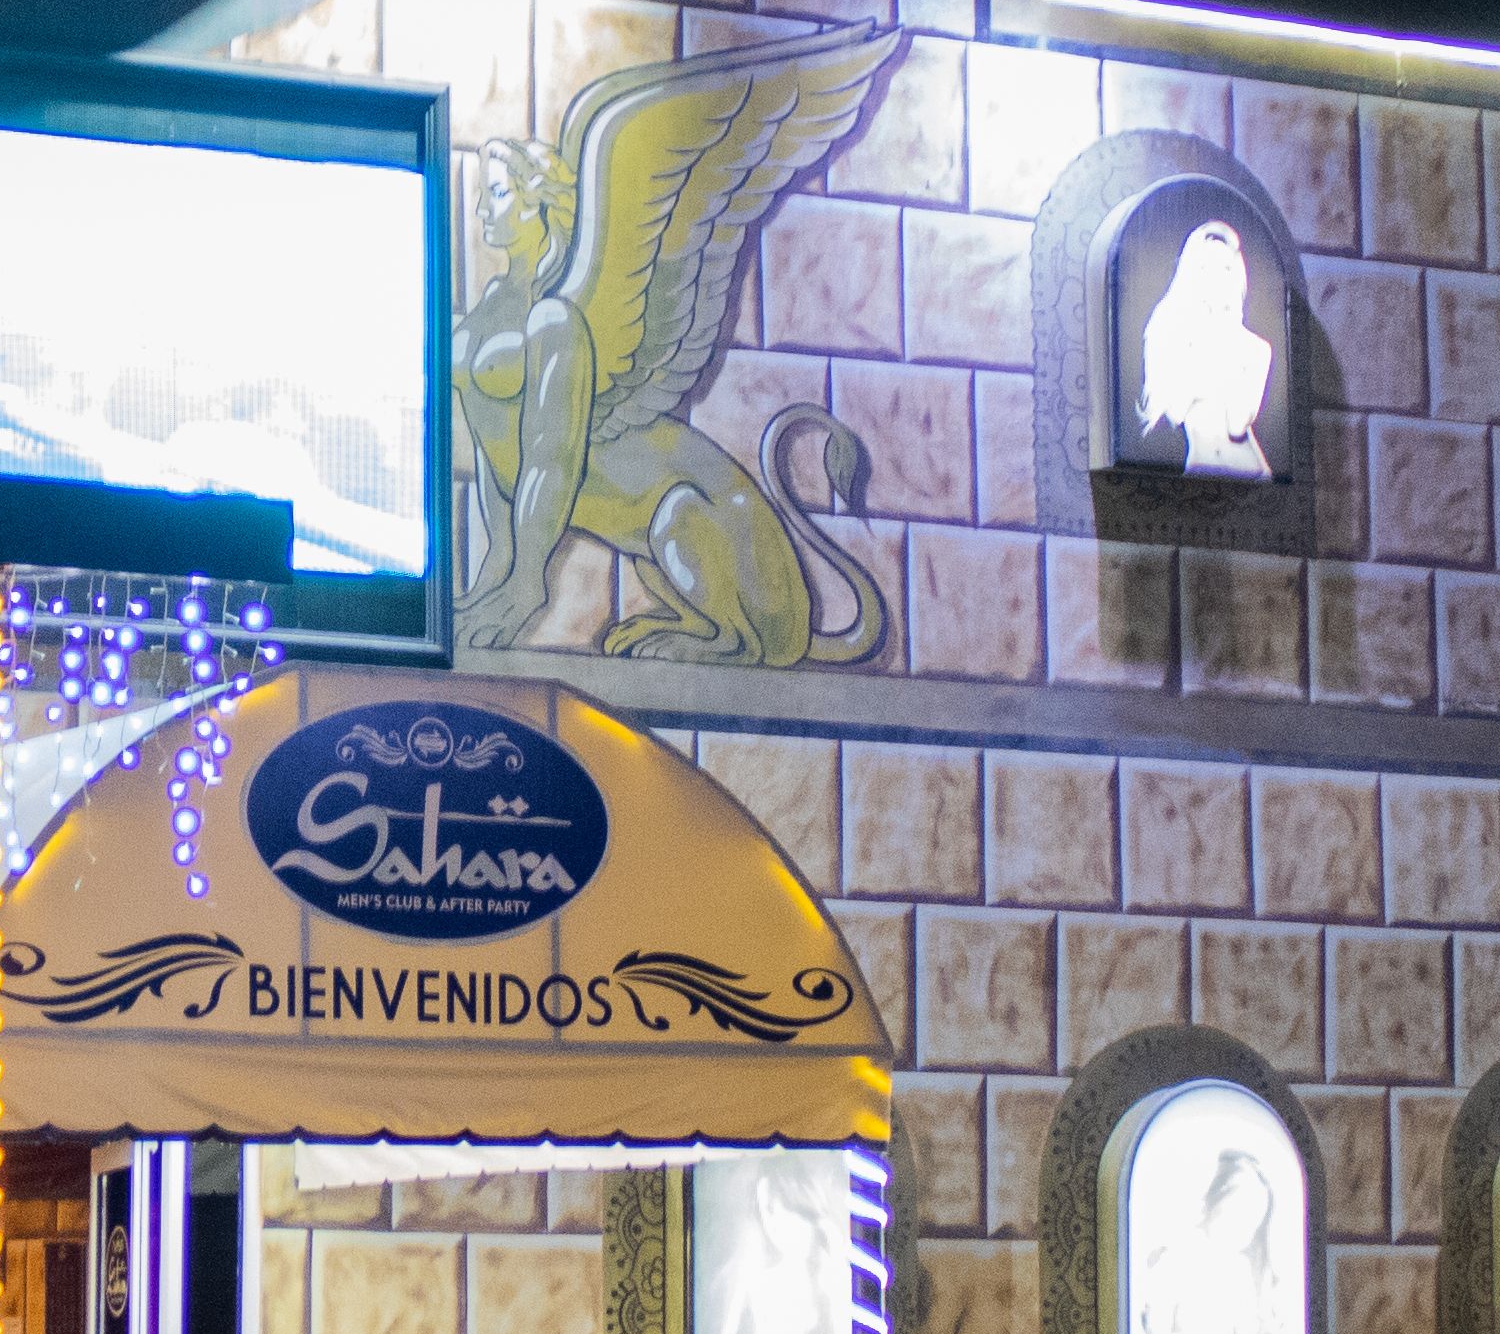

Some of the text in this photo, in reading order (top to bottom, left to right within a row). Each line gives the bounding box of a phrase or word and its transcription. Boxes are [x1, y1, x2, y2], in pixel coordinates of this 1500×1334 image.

[271, 771, 576, 892] Sahara
[337, 893, 531, 916] MEN'S CLUB & AFTER PARTY
[248, 963, 614, 1028] BIENVENIDOS
